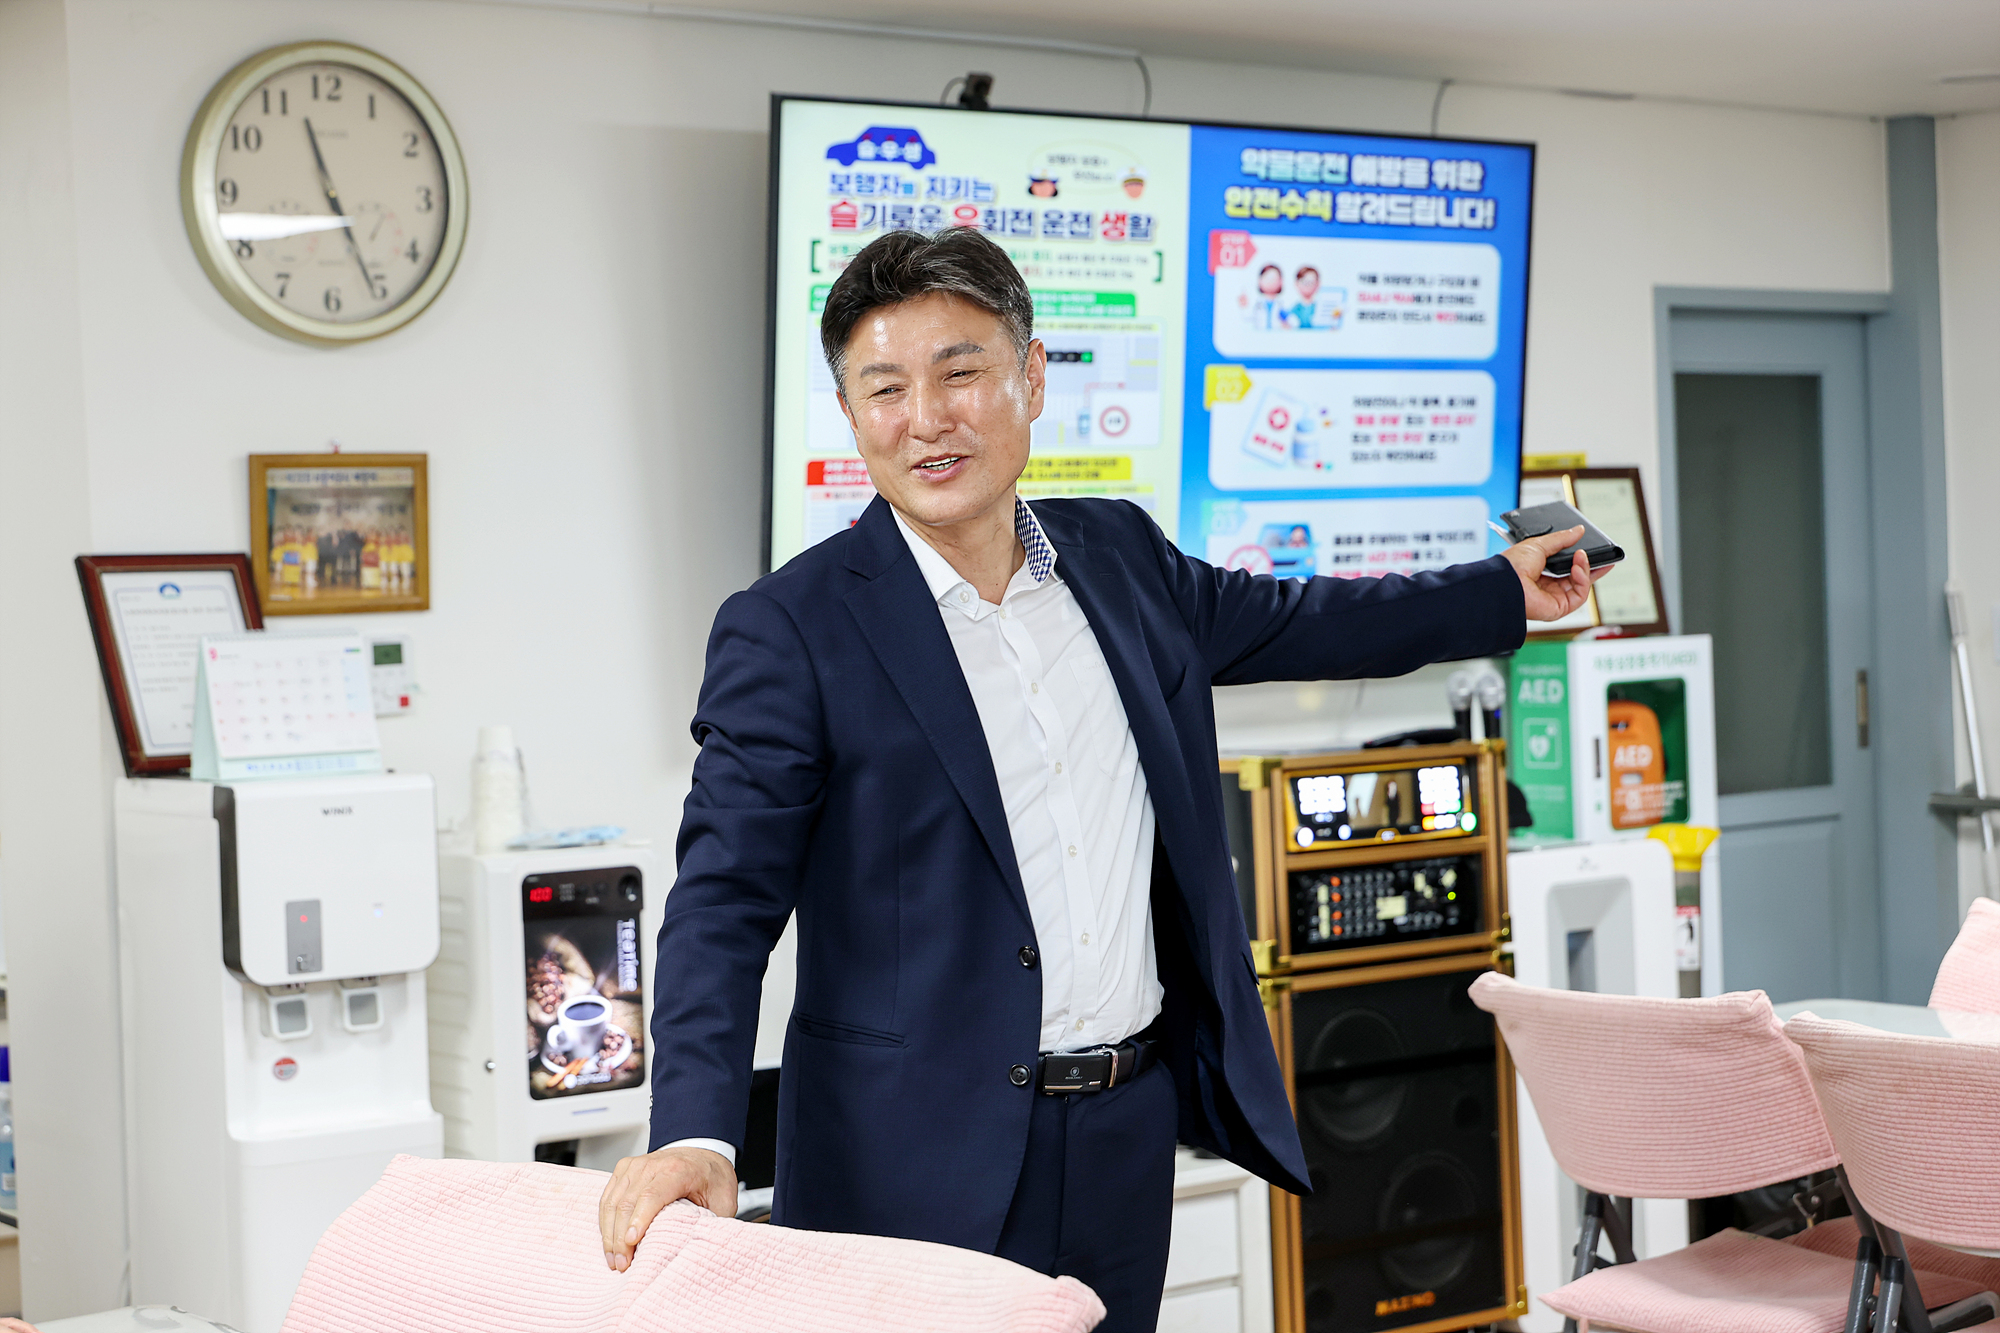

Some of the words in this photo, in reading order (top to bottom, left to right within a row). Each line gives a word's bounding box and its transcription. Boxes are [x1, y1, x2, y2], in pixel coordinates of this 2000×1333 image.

[312, 74, 342, 102] 12
[262, 89, 288, 116] 11
[368, 94, 376, 119] 1
[231, 125, 262, 153] 10
[403, 132, 419, 158] 2
[1432, 159, 1484, 191] 위한
[220, 179, 238, 206] 9
[416, 187, 432, 213] 3
[926, 175, 993, 202] 지키는
[1225, 186, 1333, 221] 안전수칙
[1335, 191, 1495, 229] 알려드립니다!
[830, 201, 942, 231] 슬기로운
[1042, 209, 1093, 239] 운전
[1100, 209, 1153, 242] 생활
[404, 238, 420, 263] 4
[1220, 245, 1245, 267] 01
[275, 273, 291, 298] 7
[322, 287, 342, 313] 6
[1517, 679, 1565, 704] AED
[1613, 744, 1653, 767] AED
